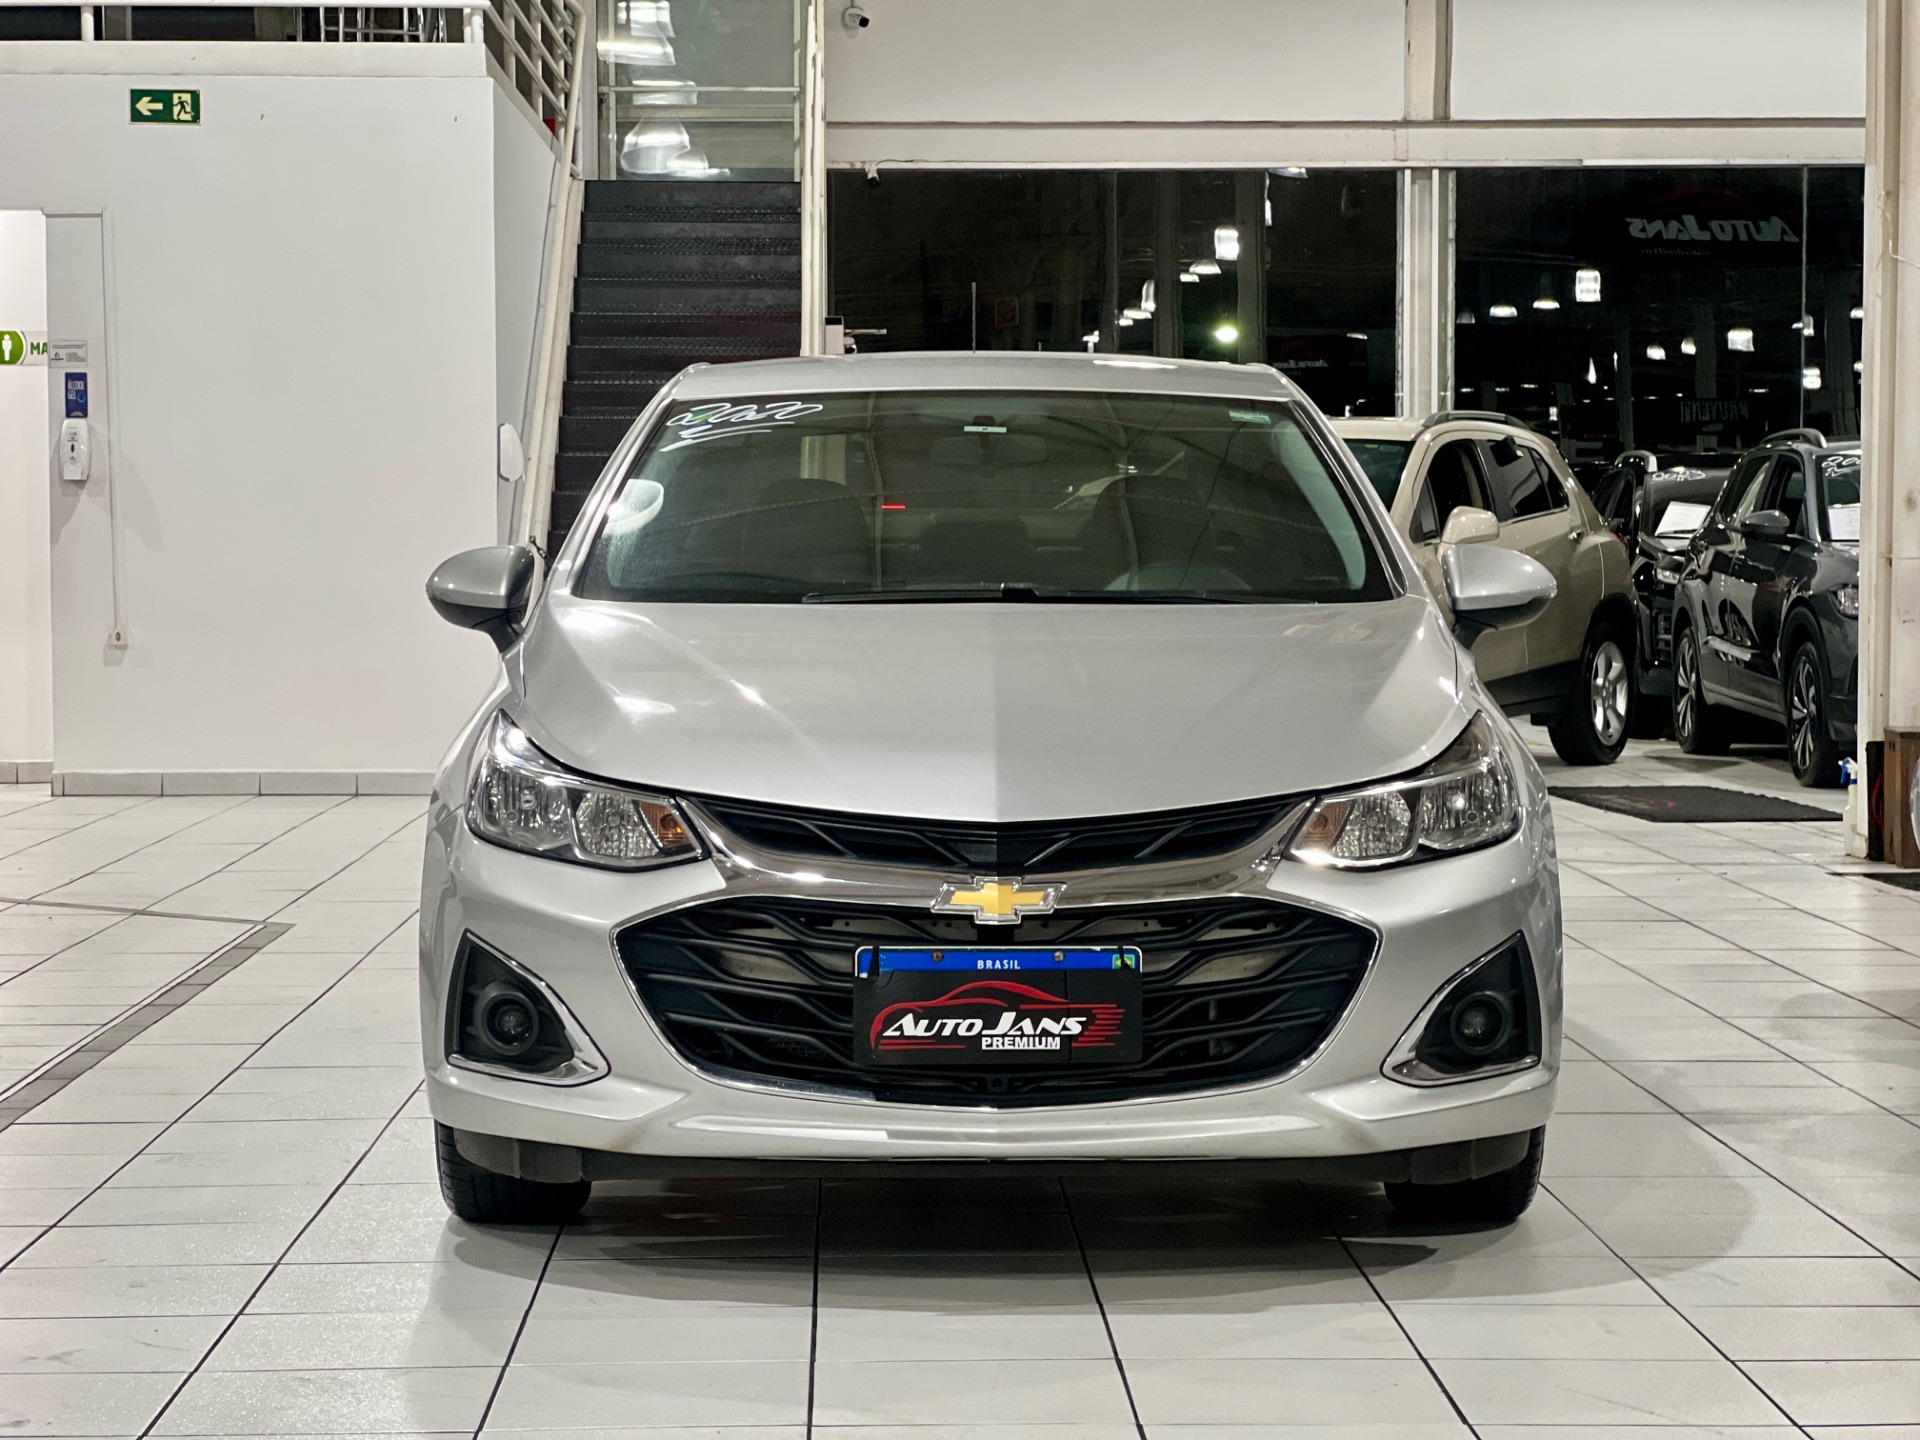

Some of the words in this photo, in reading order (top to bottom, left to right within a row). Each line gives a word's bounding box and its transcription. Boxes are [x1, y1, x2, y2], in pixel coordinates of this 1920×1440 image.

[977, 960, 1021, 970] BRASIL
[883, 1012, 984, 1037] AUTO
[981, 1012, 1087, 1036] JANS
[981, 1036, 1061, 1050] PREMIUM
